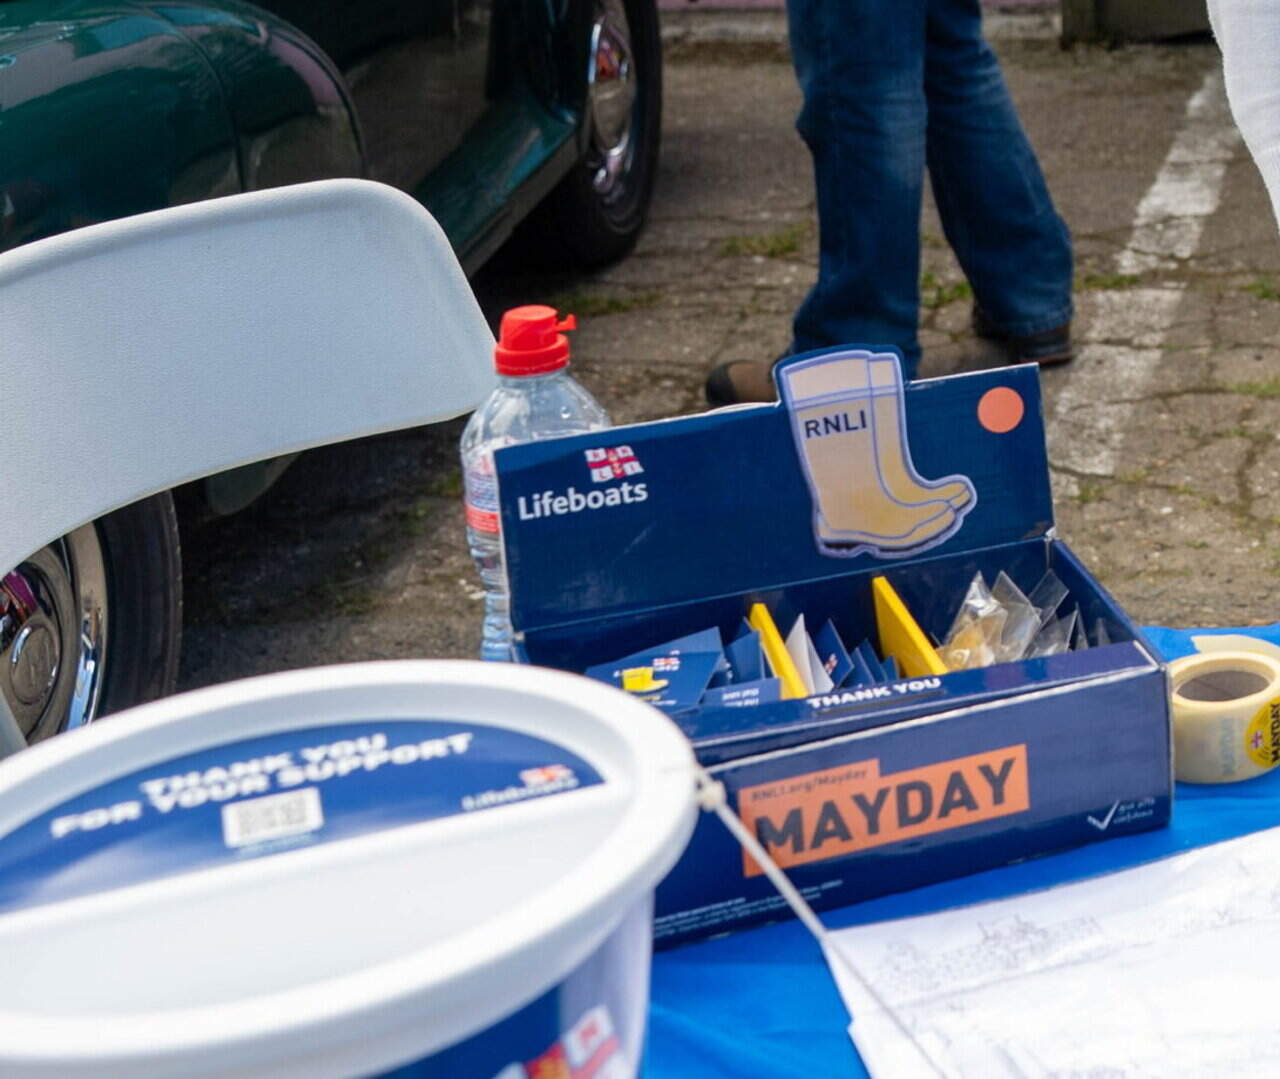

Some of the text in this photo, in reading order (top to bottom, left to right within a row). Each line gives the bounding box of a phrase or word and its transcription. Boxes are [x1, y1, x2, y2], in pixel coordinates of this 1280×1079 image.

[804, 410, 868, 439] RNLI
[517, 481, 649, 520] Lifeboats
[806, 677, 942, 710] THANK YOU
[139, 732, 388, 795] THANK YOU
[1270, 703, 1280, 764] MAYDAY
[51, 732, 474, 839] FOR YOUR SUPPORT
[754, 757, 1017, 854] MAYDAY
